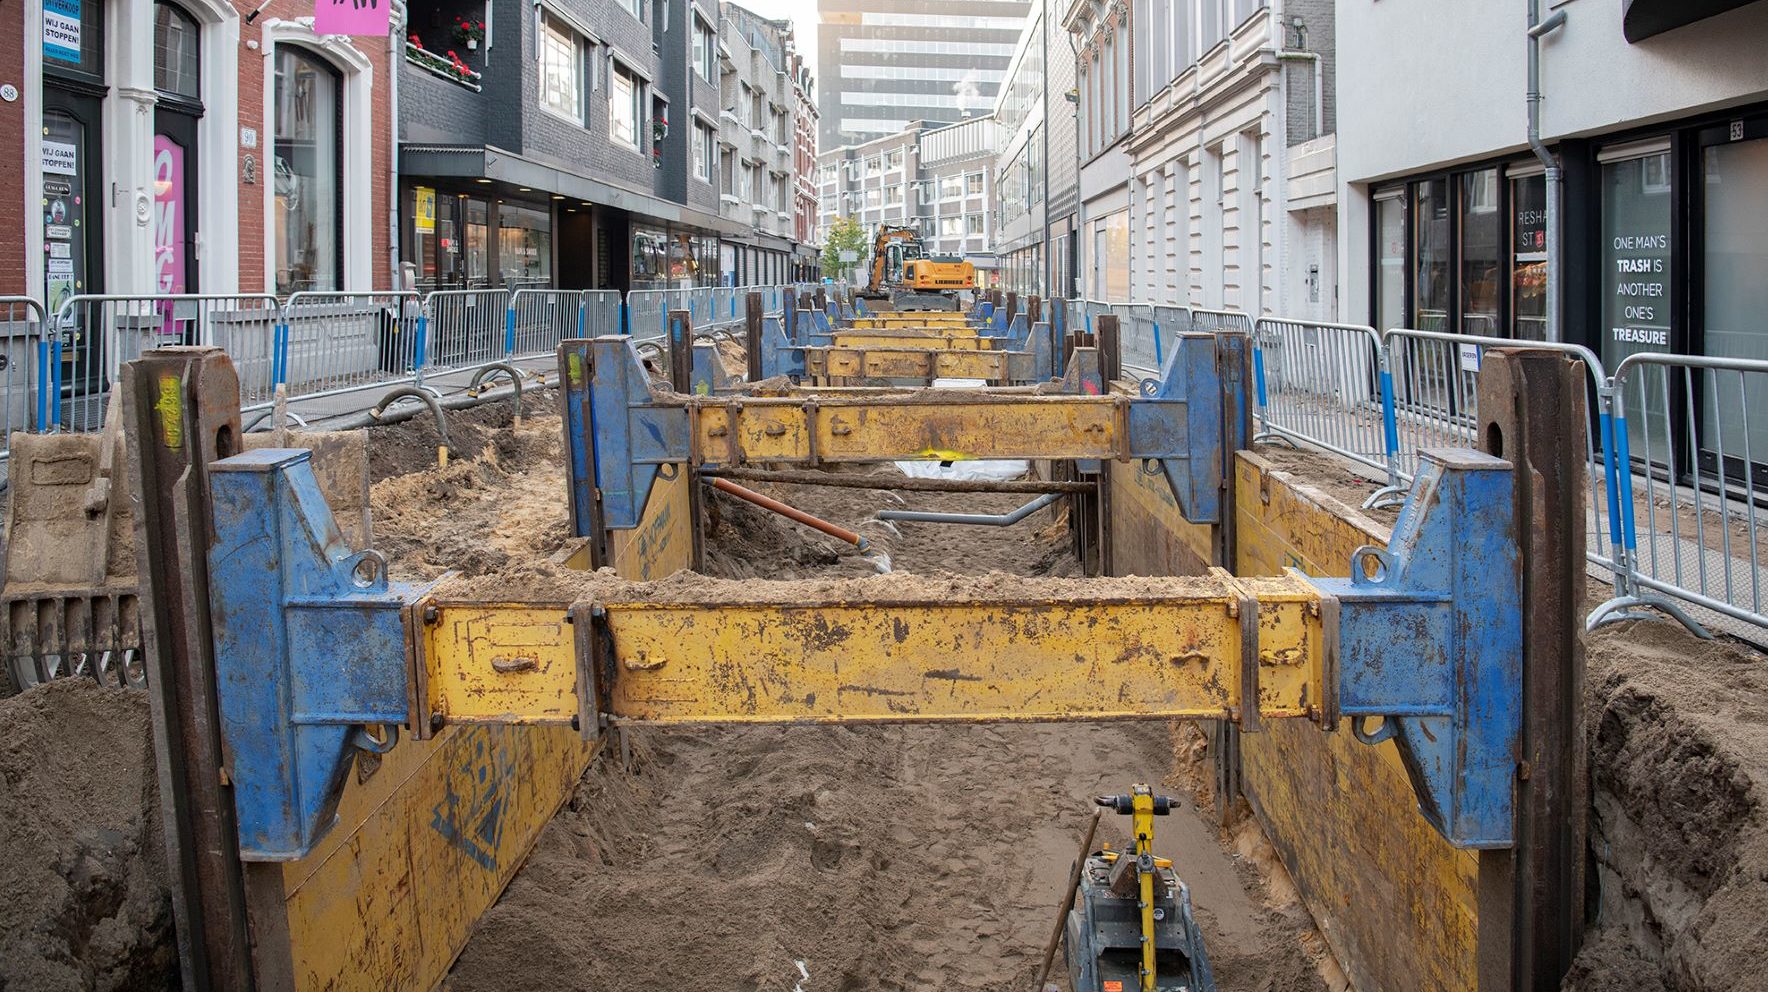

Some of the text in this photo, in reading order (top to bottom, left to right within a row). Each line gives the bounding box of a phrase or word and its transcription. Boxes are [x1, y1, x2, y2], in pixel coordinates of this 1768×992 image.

[45, 18, 79, 33] WIJ GAAN
[45, 29, 79, 43] STOPPEN!
[4, 86, 14, 98] 88
[1731, 122, 1742, 138] 53
[55, 149, 74, 159] GAAN
[1613, 235, 1667, 250] ONE MAN'S
[1617, 259, 1663, 273] TRASH IS
[1617, 283, 1662, 296] ANOTHER
[1625, 306, 1654, 320] ONE'S
[1612, 327, 1666, 345] TREASURE
